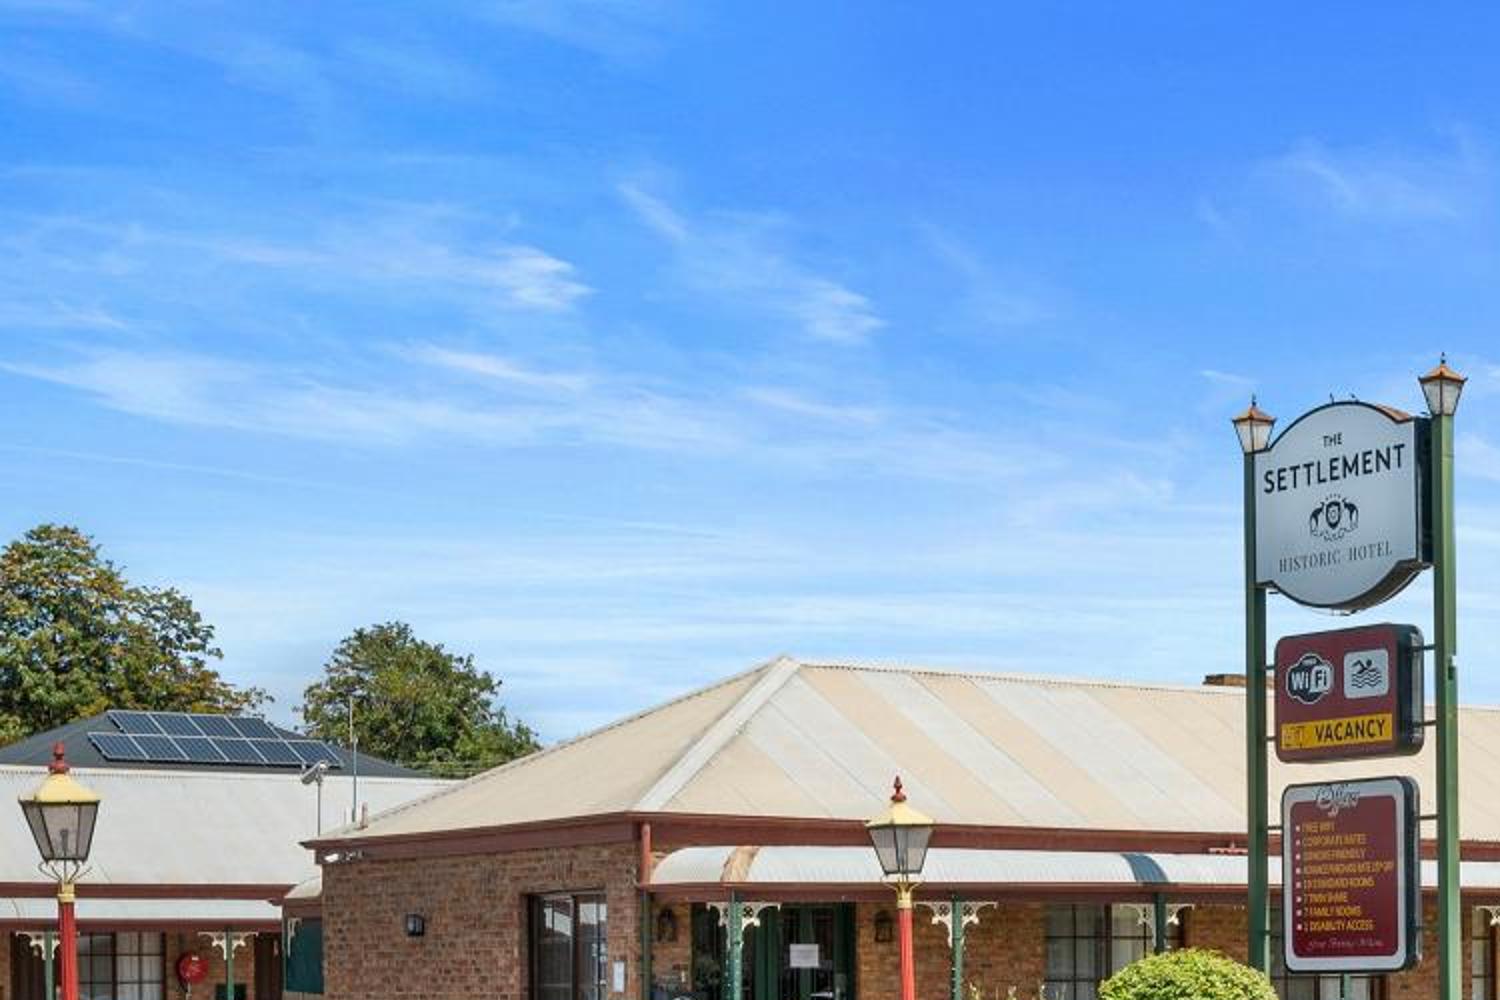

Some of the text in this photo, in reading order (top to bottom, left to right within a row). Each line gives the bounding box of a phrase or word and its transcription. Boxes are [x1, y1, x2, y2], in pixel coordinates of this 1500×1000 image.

[1323, 432, 1343, 447] THE
[1263, 443, 1405, 493] SETTLEMENT
[1279, 541, 1393, 573] HISTORIC HOTEL
[1315, 719, 1386, 743] VACANCY
[1346, 919, 1374, 931] ACCESS
